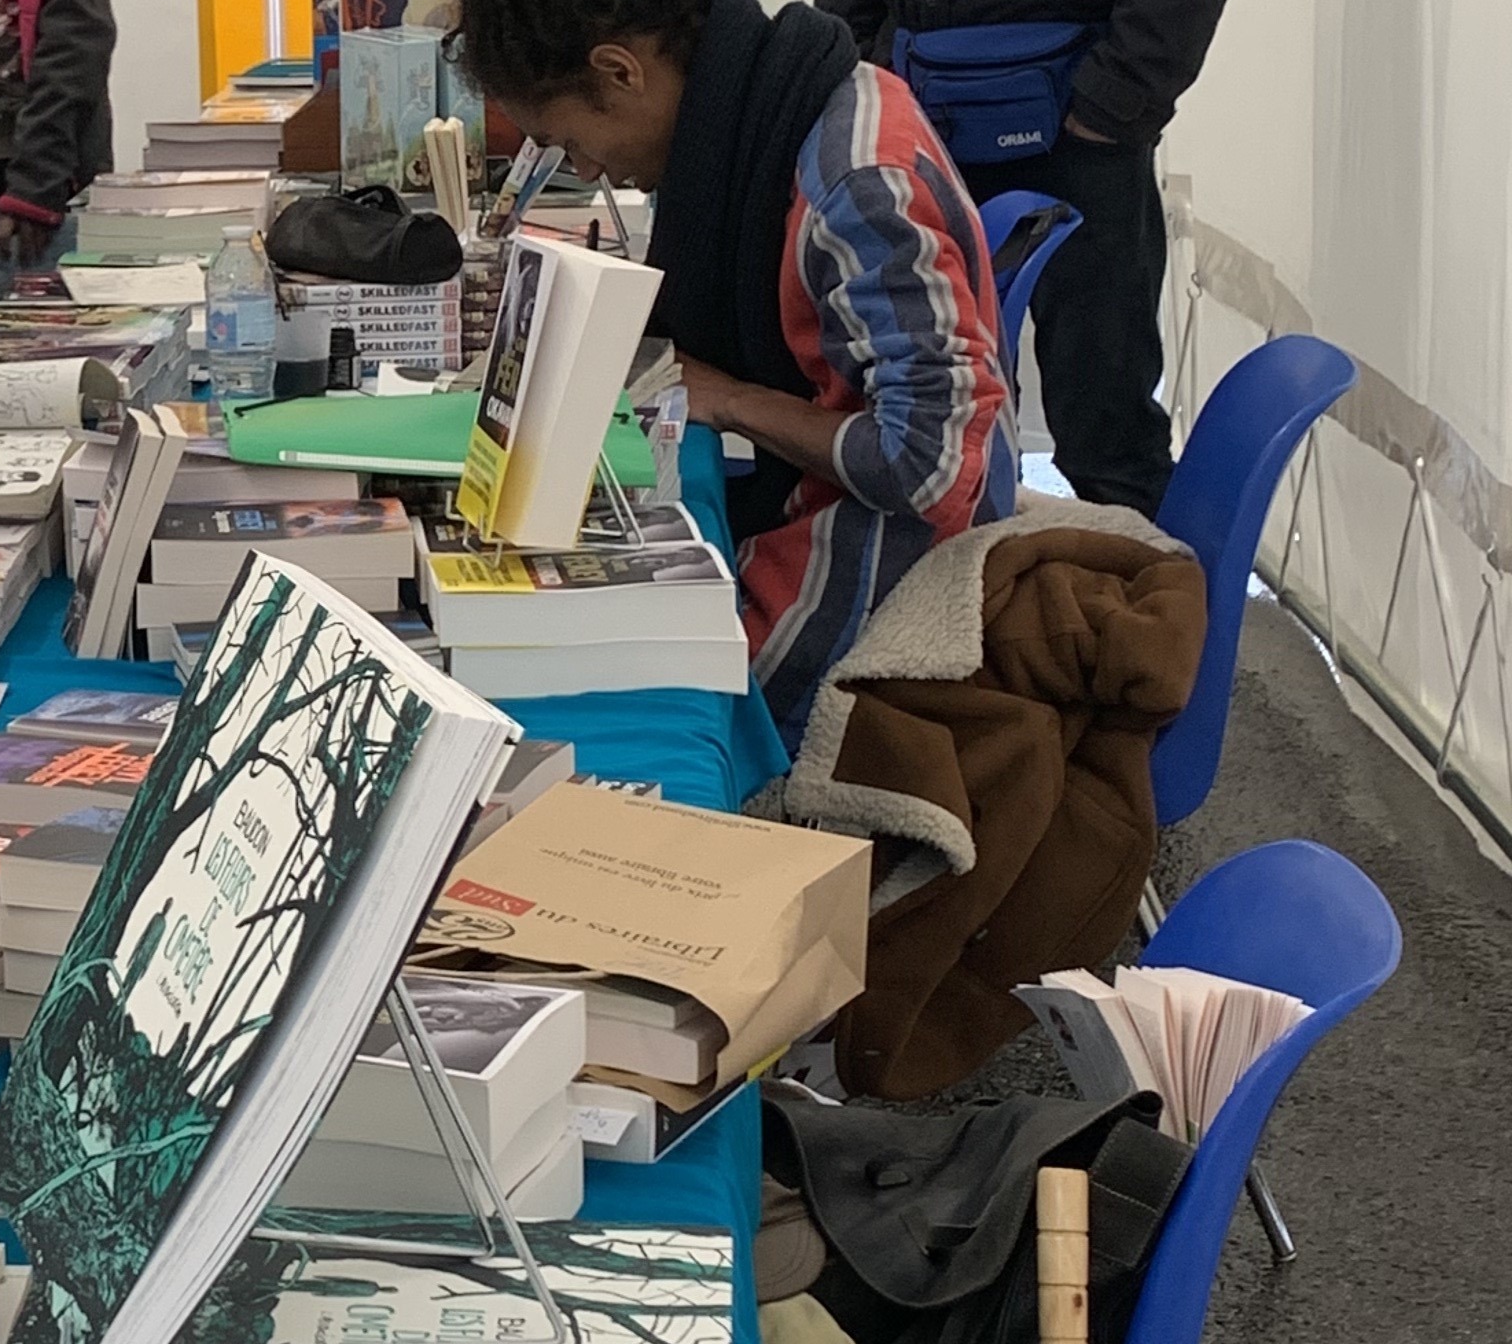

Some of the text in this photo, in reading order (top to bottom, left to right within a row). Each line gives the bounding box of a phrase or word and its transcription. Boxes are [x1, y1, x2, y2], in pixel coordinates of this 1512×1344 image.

[359, 286, 438, 298] SKILLEDFAST
[357, 304, 436, 317] SKILLEDFAST
[359, 322, 438, 334] SKILLEDFAST
[359, 340, 438, 352] SKILLEDFAST
[233, 799, 273, 859] BAUDOIN
[458, 885, 521, 912] Sud
[536, 907, 578, 924] du
[587, 919, 728, 962] Libraires
